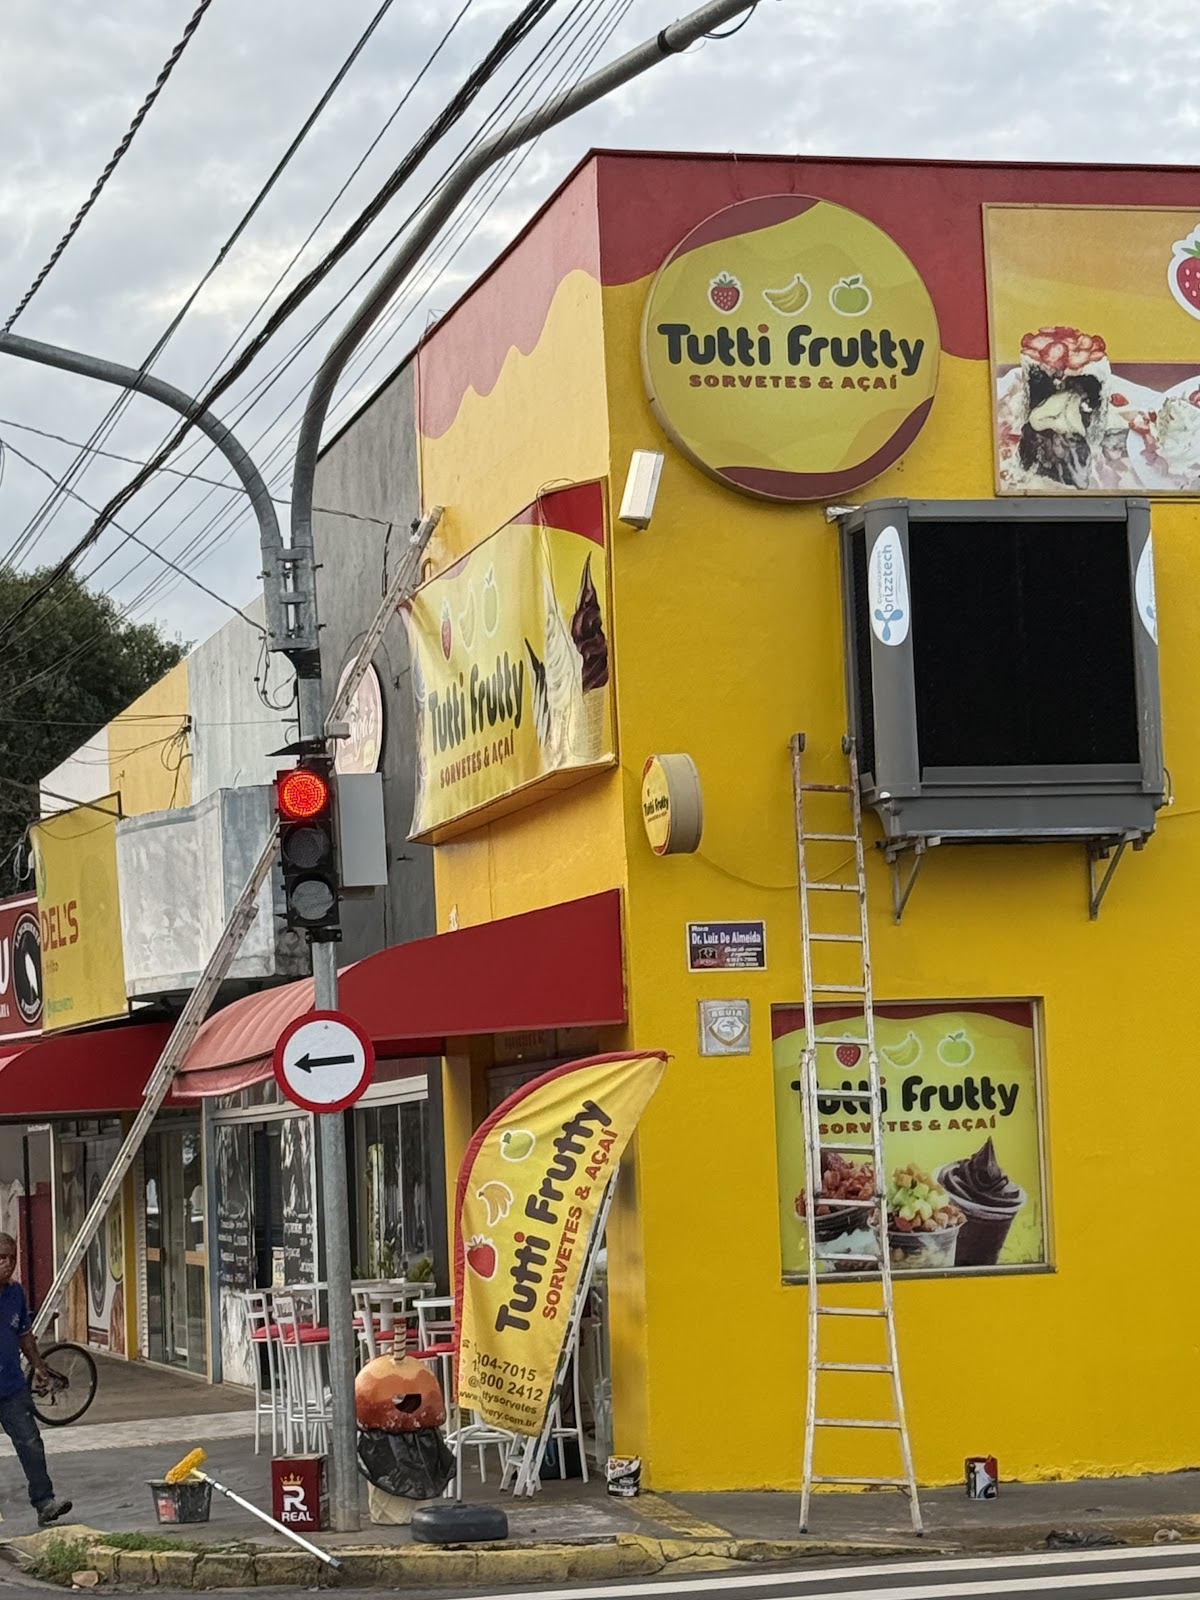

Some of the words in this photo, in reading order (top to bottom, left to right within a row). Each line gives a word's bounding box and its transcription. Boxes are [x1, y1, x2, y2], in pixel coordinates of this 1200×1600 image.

[657, 323, 771, 367] Tutti
[689, 374, 812, 388] SORVETES
[817, 375, 834, 389] &
[841, 374, 898, 392] AÇAÍ
[882, 544, 894, 613] brizztech
[428, 671, 467, 757] Tutti
[440, 749, 482, 789] SORVETES
[484, 746, 490, 768] &
[492, 728, 515, 765] AÇAÍ
[692, 933, 702, 944] Dr.
[703, 932, 719, 944] Luiz
[720, 931, 730, 944] De
[732, 931, 761, 944] Almeida
[818, 1118, 923, 1135] SORVTES
[927, 1119, 942, 1131] &
[948, 1115, 997, 1132] AÇAÍ
[495, 1231, 551, 1332] Tutti
[525, 1100, 612, 1225] Frutty
[542, 1205, 583, 1320] SORVETES
[574, 1186, 592, 1201] &
[585, 1127, 619, 1181] AÇAÍ
[506, 1381, 544, 1402] 2412
[281, 1511, 314, 1522] REAL
